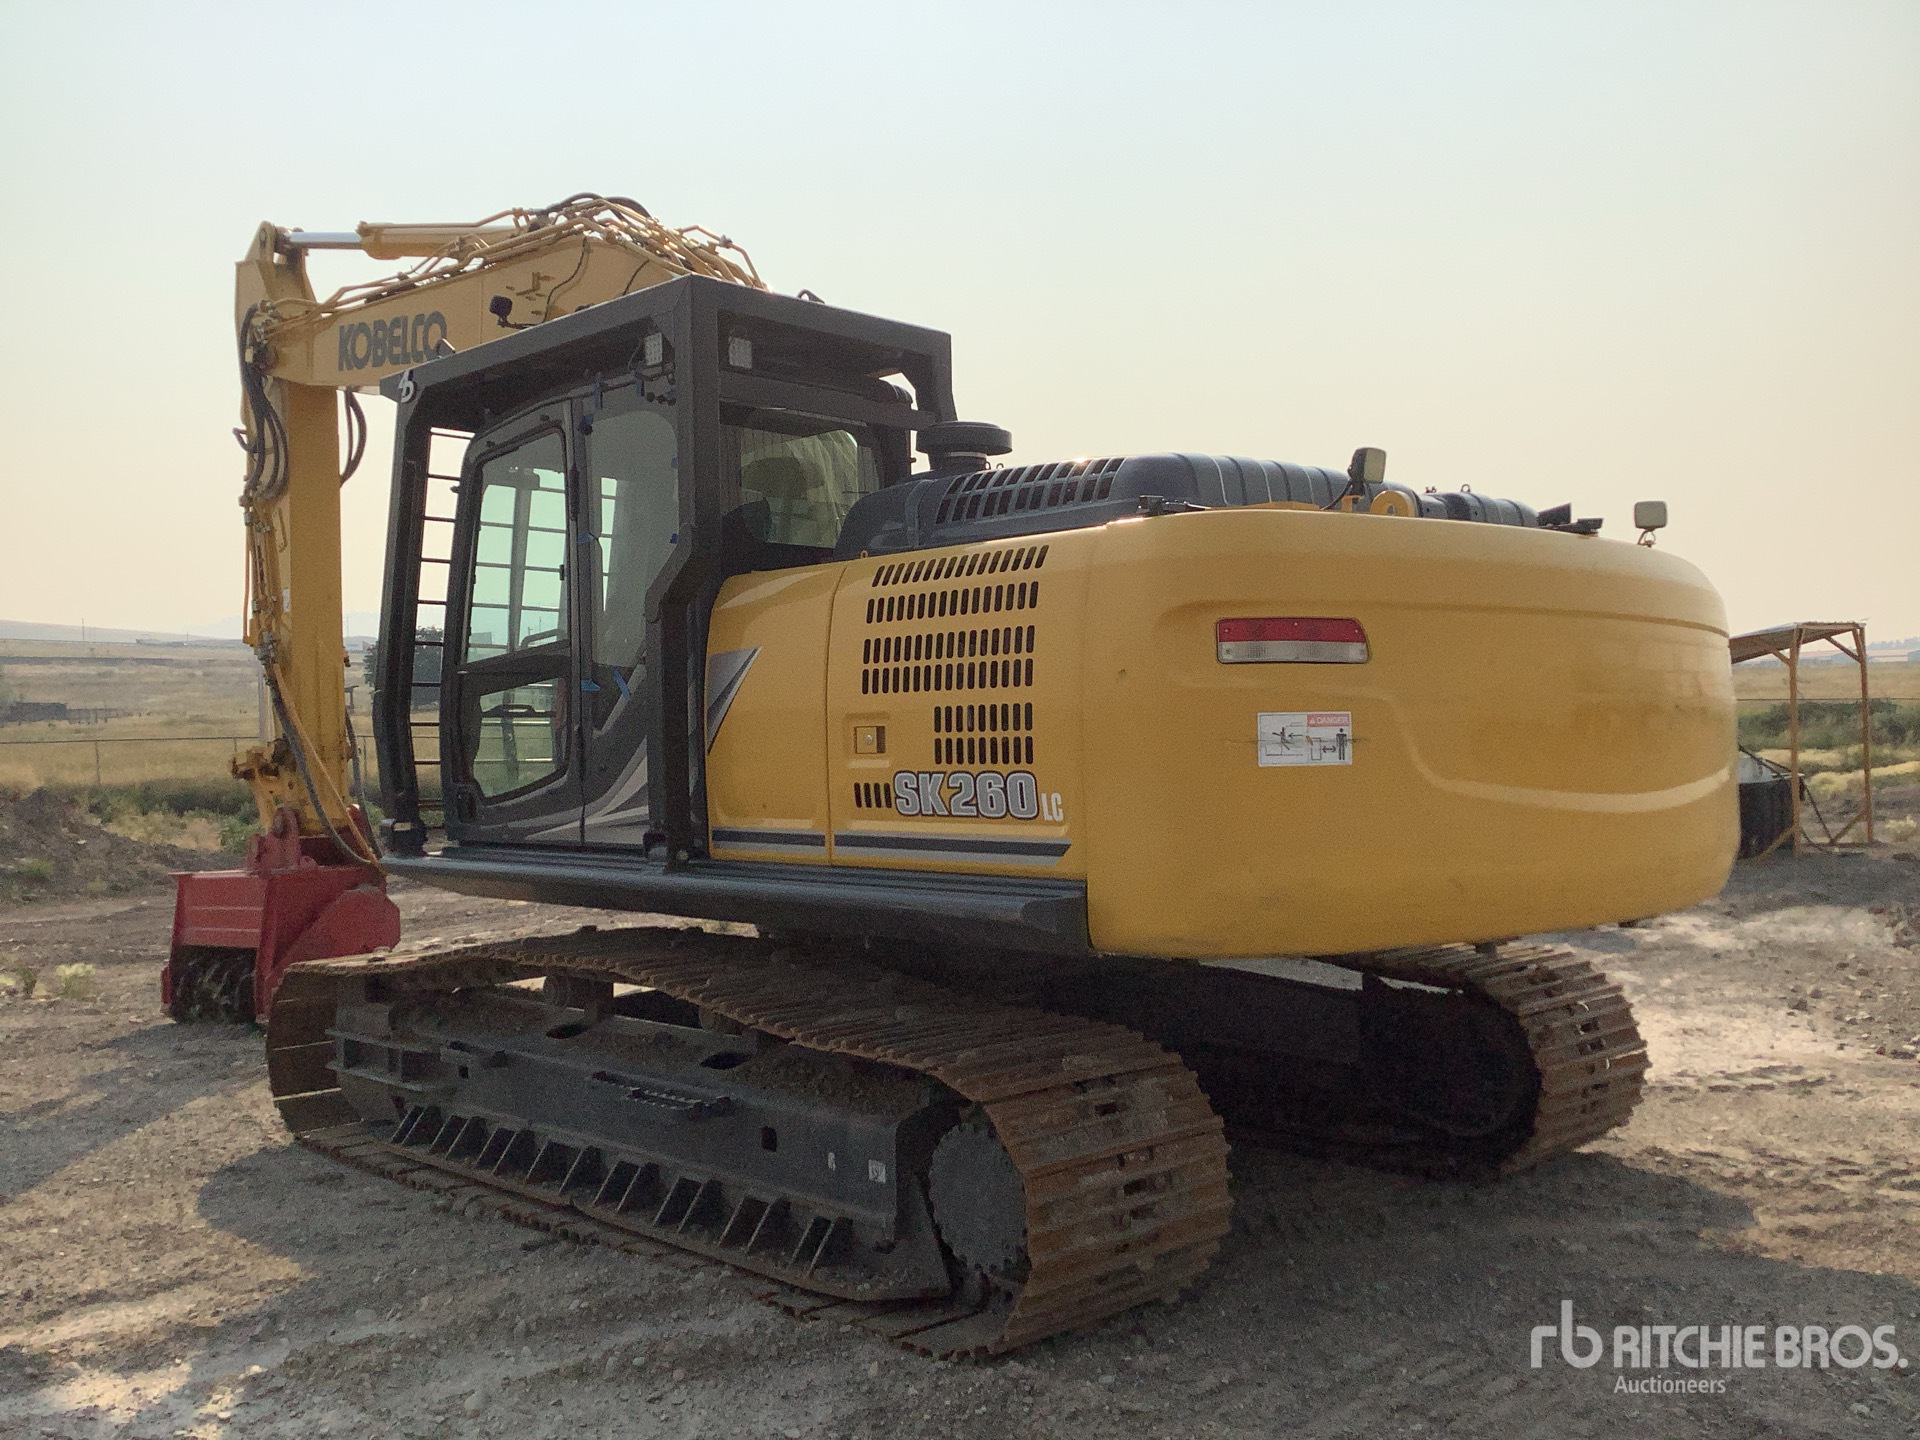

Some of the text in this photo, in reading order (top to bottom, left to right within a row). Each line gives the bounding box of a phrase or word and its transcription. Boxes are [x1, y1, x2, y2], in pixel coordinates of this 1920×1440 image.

[337, 311, 447, 371] KOBELCO
[1317, 715, 1348, 724] DANGER
[894, 770, 1064, 821] SK260 LC
